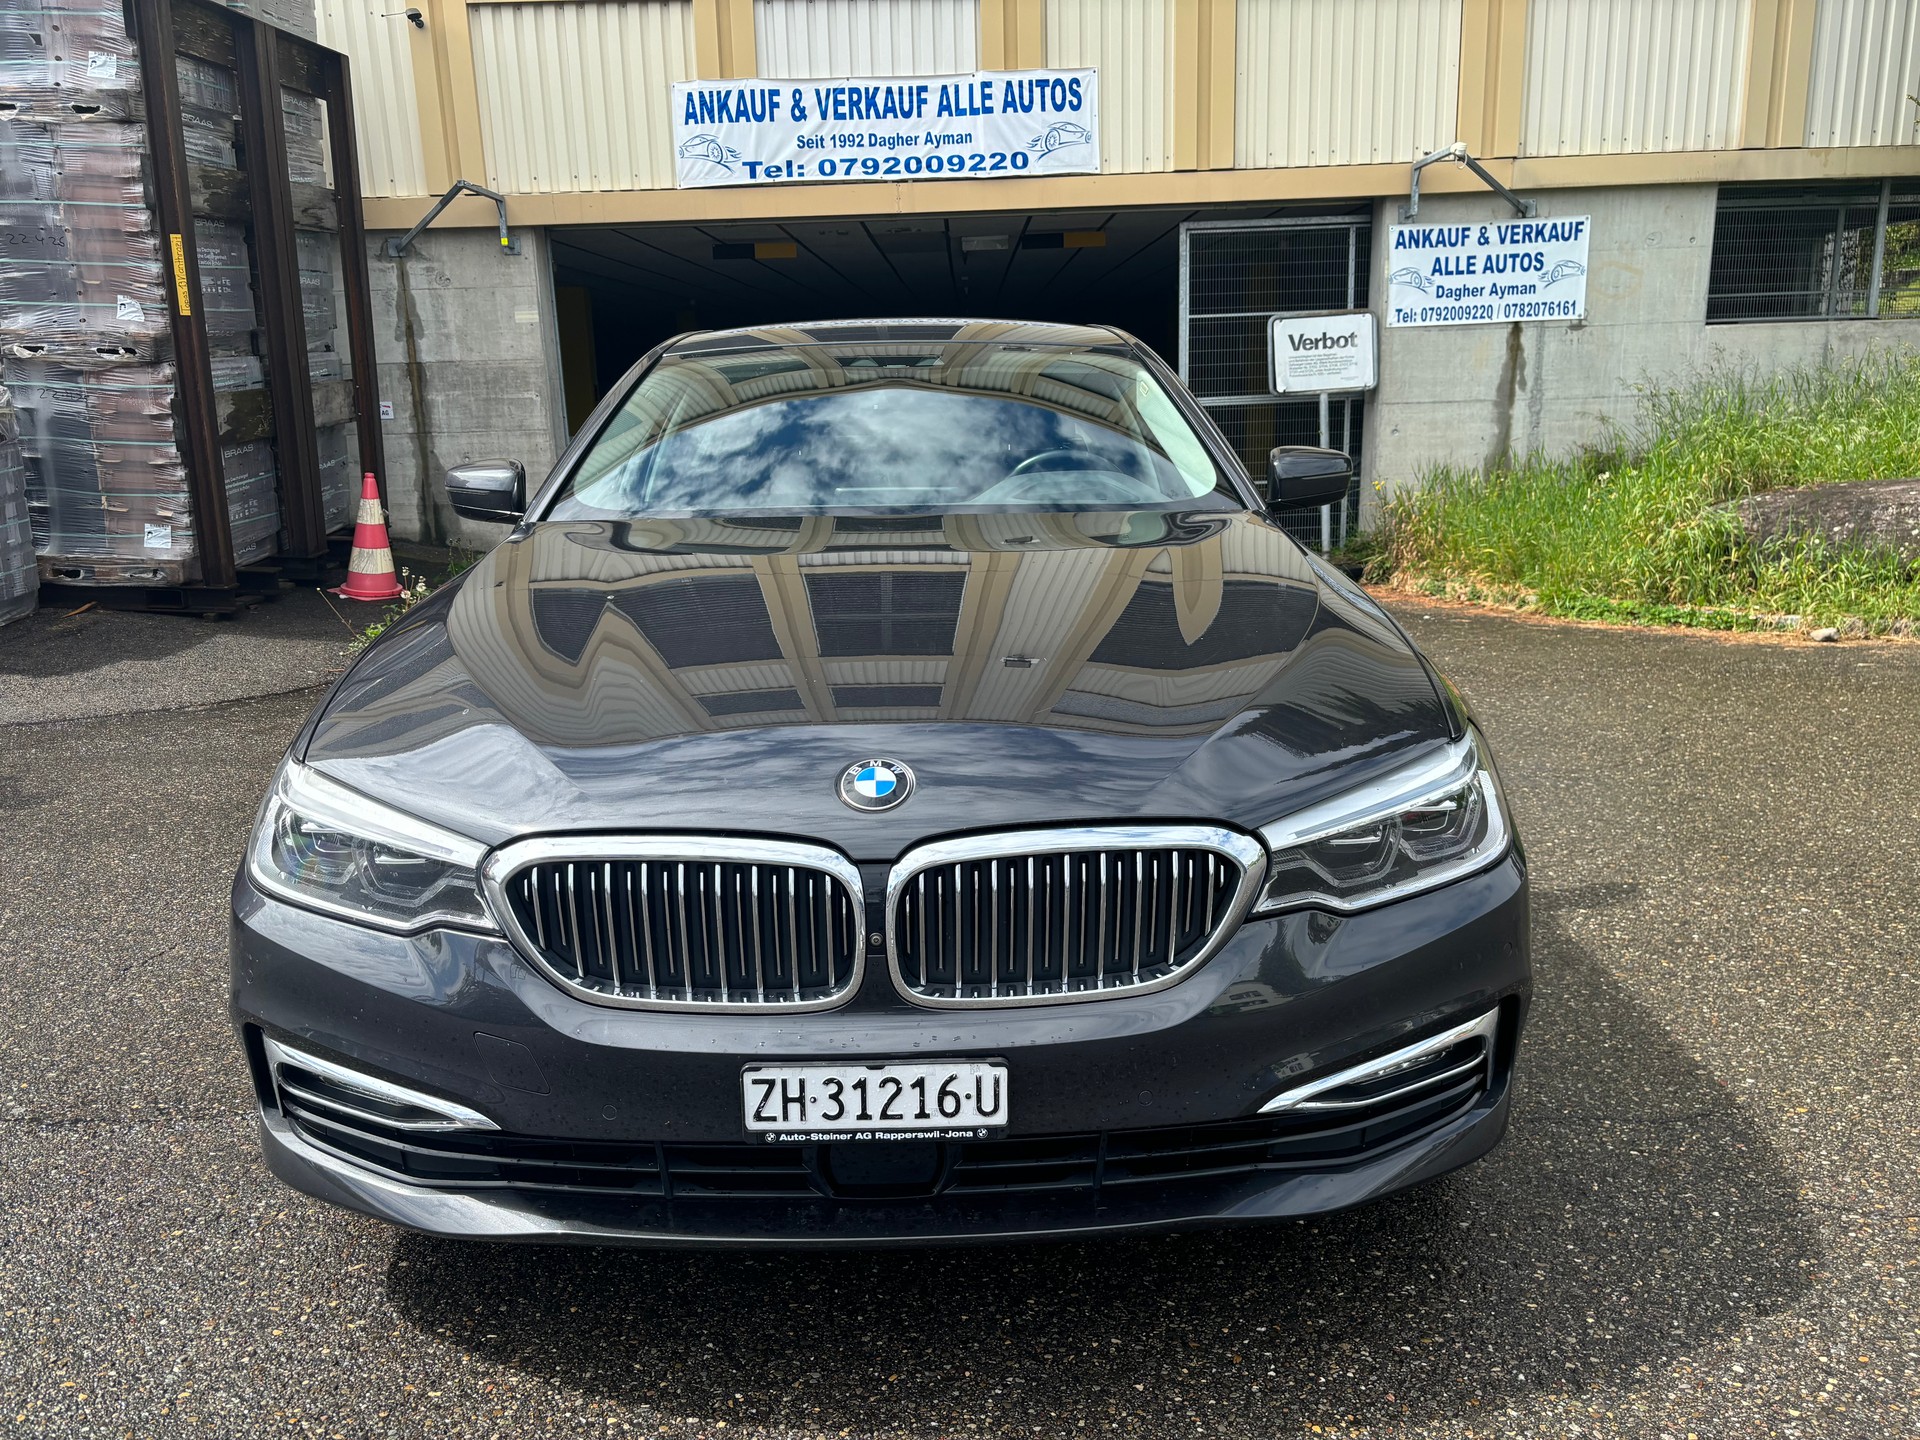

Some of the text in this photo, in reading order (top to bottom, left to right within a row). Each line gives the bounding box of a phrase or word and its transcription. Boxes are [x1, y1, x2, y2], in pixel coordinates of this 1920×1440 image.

[685, 77, 1083, 125] ANKAUF & VERKAUF ALLE AUTOS
[797, 131, 972, 150] Seit 1992 Dagher Ayman
[742, 151, 1029, 179] Tel: 0792009220
[1395, 221, 1584, 250] ANKAUF & VERKAUF
[1431, 252, 1544, 276] ALLE AUTOS
[1436, 282, 1536, 301] Dagher Ayman
[1395, 307, 1417, 324] Tel:
[1504, 300, 1577, 319] 0782076161
[1288, 331, 1358, 351] Verbot
[224, 444, 254, 459] BRAAS
[848, 759, 904, 775] BMW
[779, 1130, 973, 1141] Auto-Steiner AG Rapperswil-Jona
